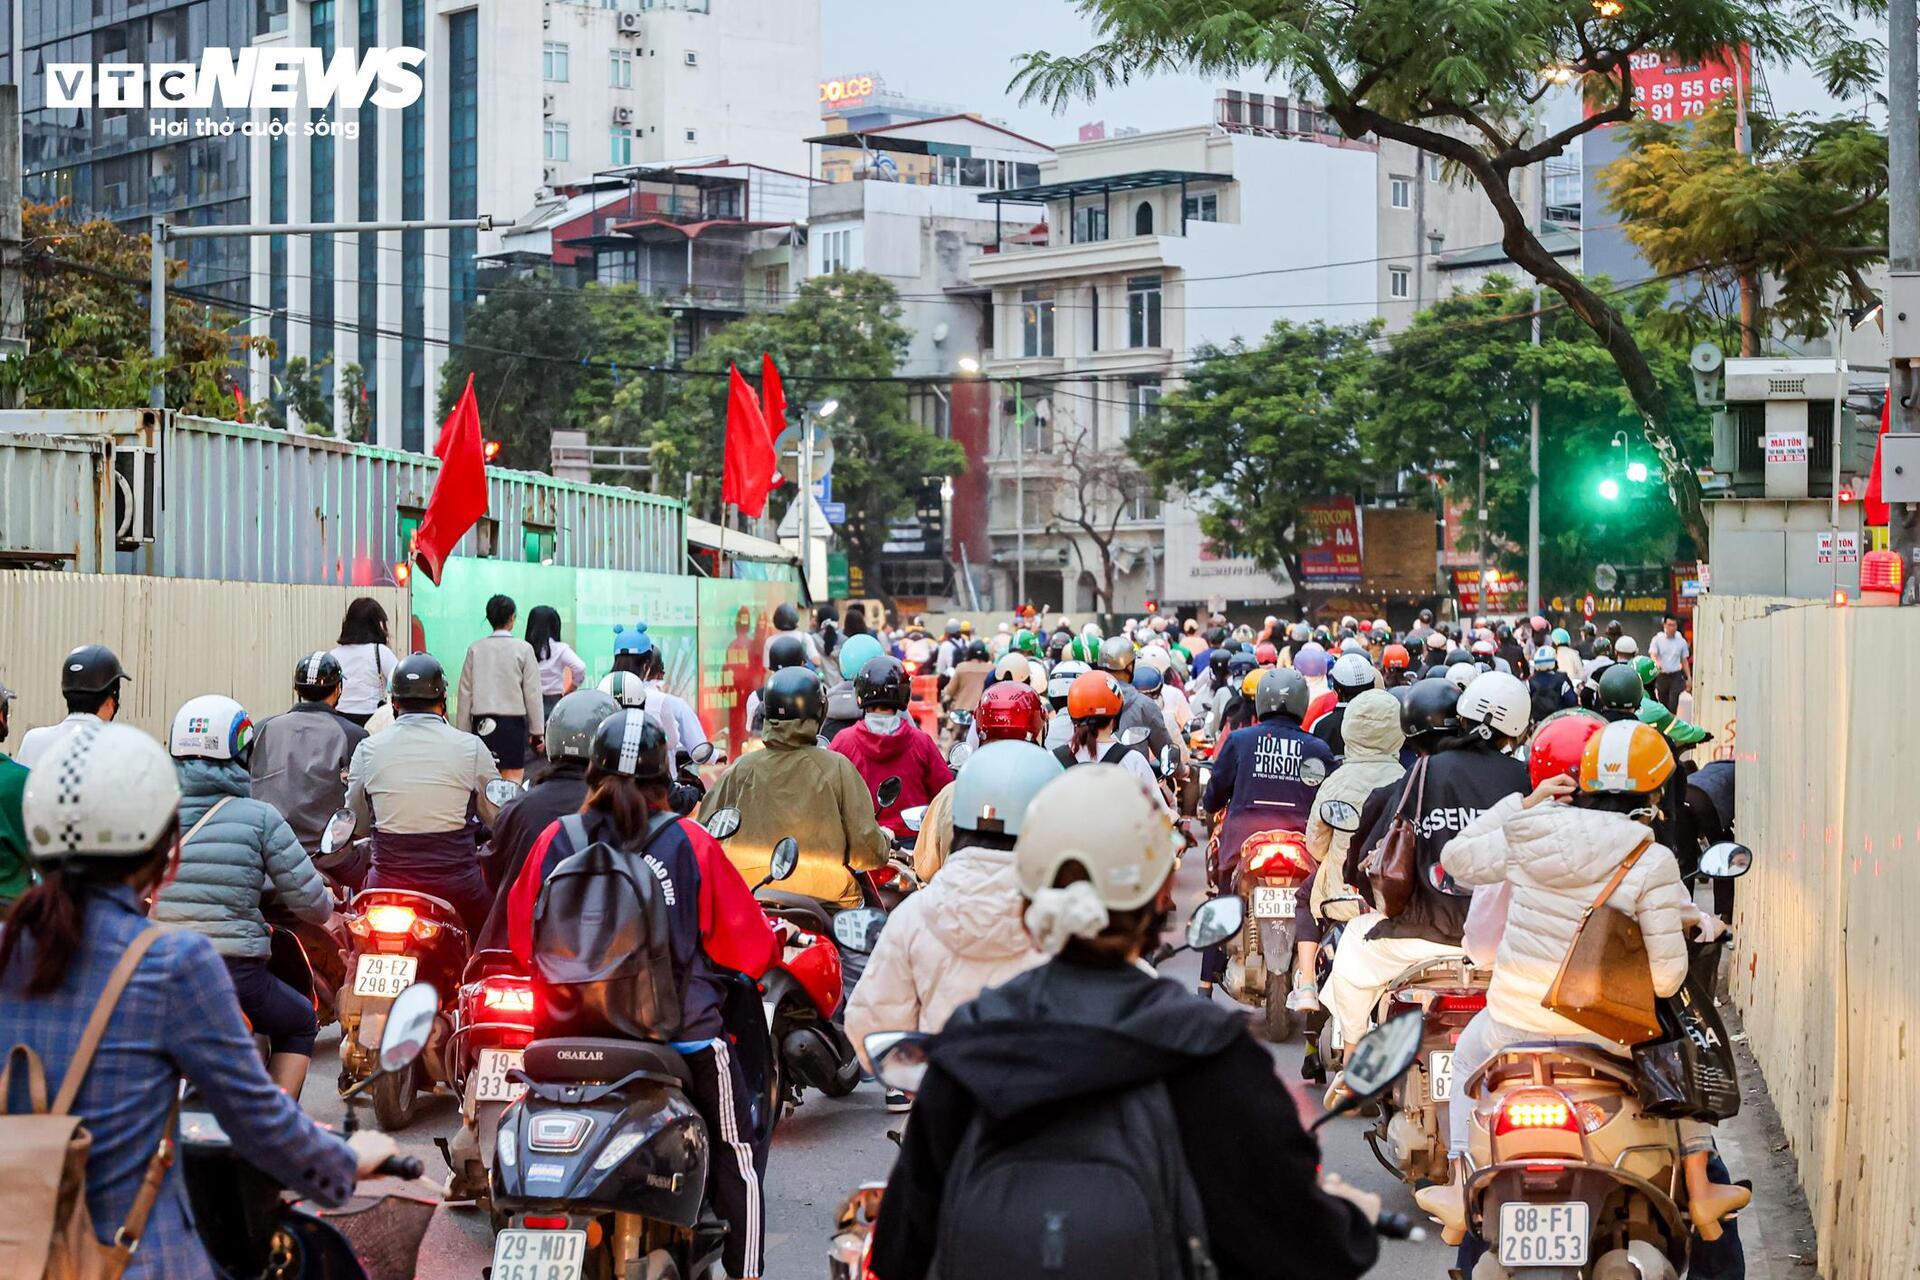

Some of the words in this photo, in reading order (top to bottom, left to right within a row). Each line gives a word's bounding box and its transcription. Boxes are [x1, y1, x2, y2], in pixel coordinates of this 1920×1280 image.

[1651, 82, 1674, 100] 59
[1681, 80, 1704, 98] 55
[1651, 102, 1672, 120] 91
[1255, 755, 1301, 777] PRISON
[1262, 889, 1295, 901] 29-X5
[366, 959, 408, 977] 29-E2
[557, 1050, 604, 1060] OSAKAR
[1515, 1207, 1572, 1232] 88-F1
[502, 1235, 577, 1261] 29-MD1
[1505, 1235, 1581, 1261] 260.53
